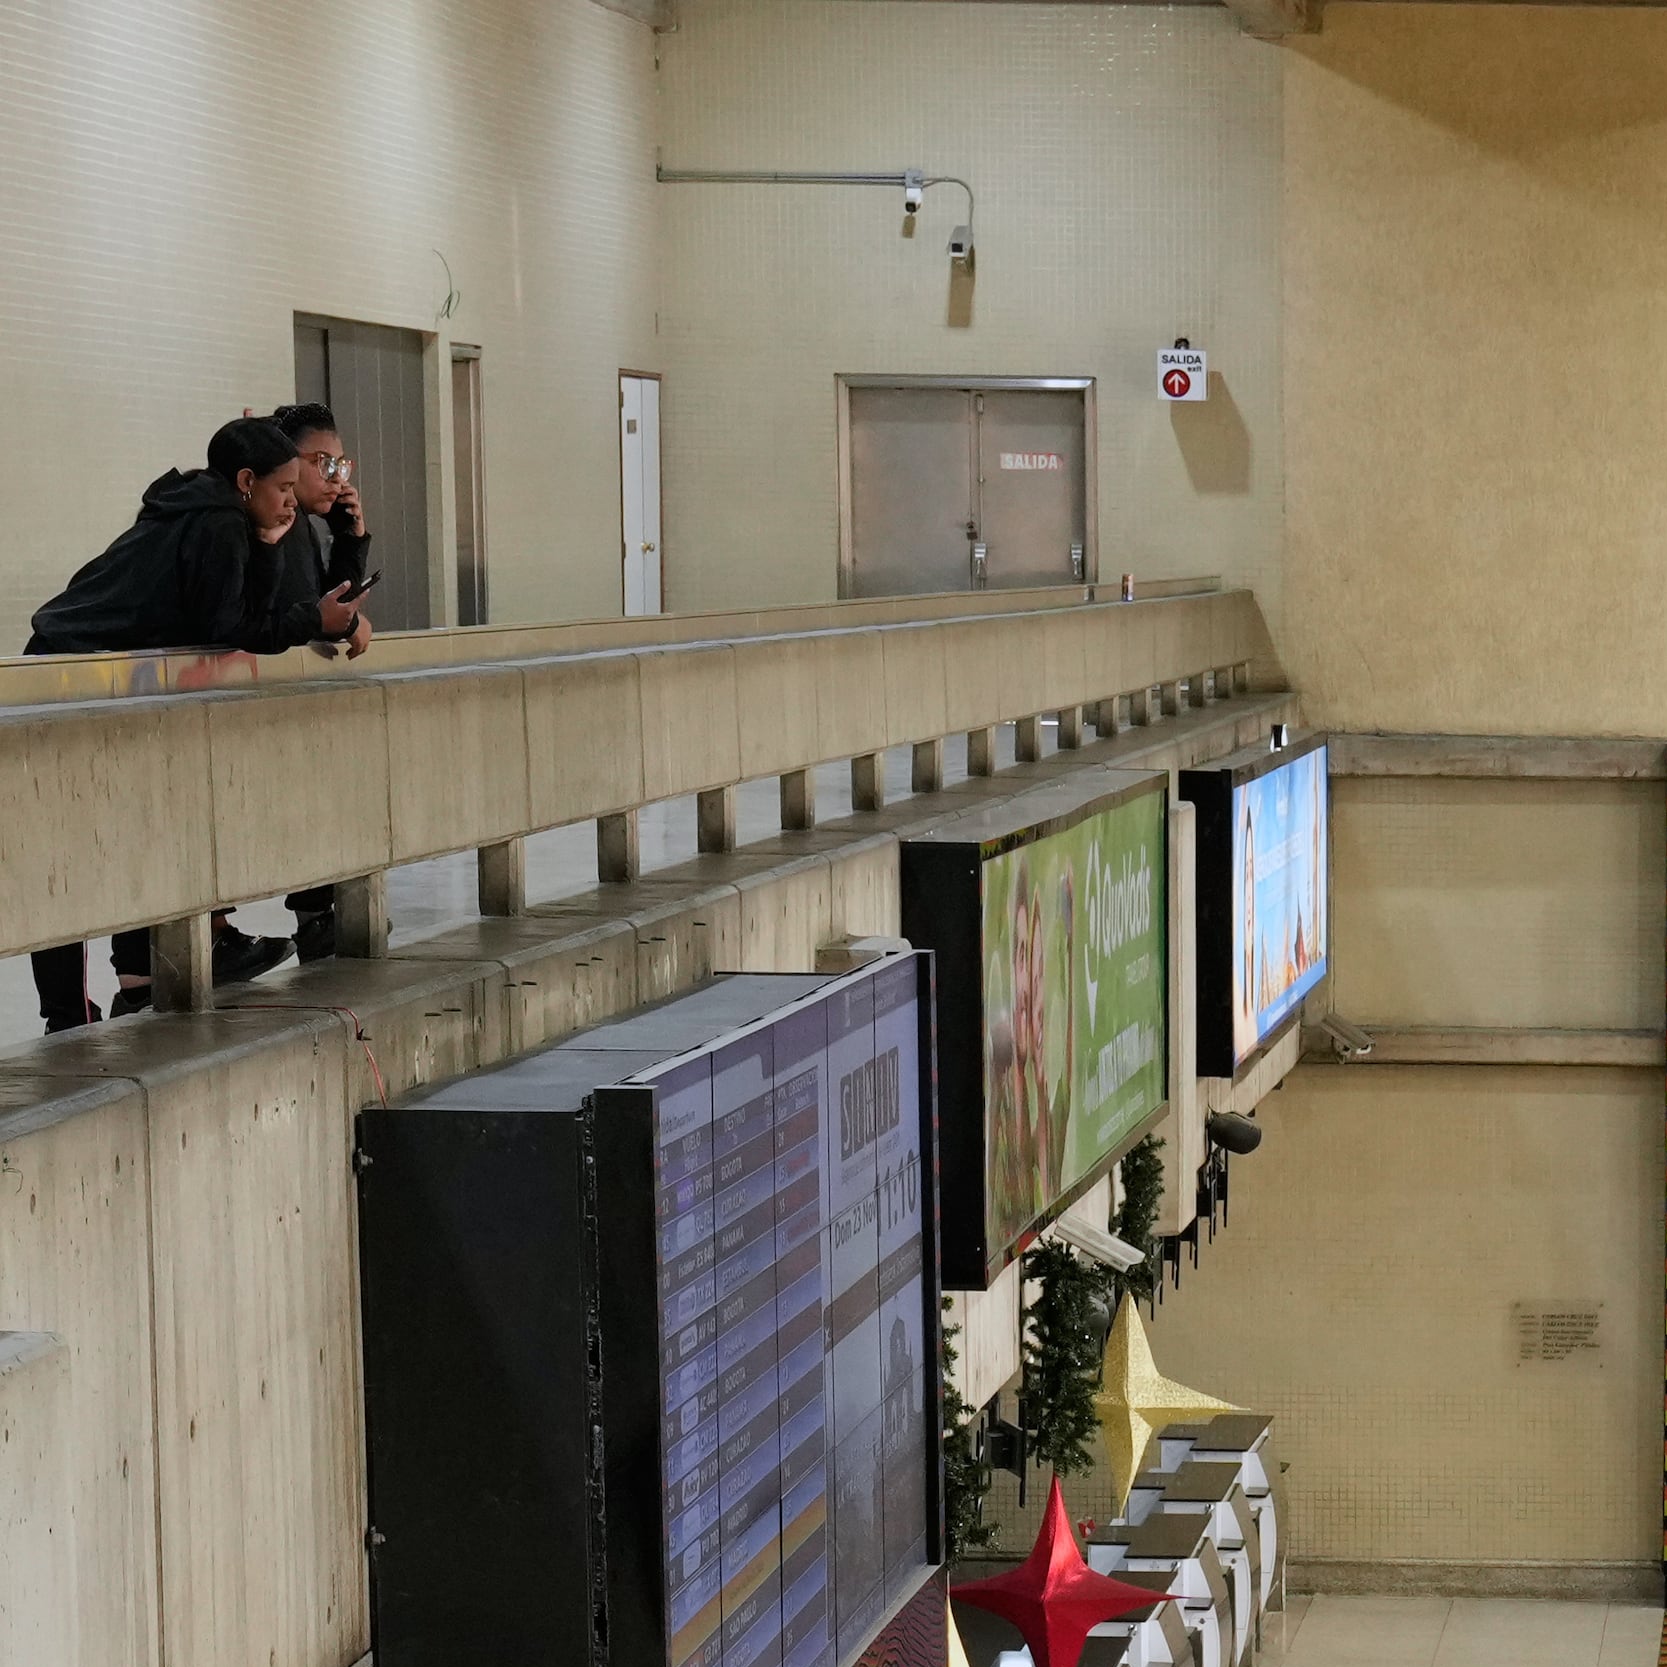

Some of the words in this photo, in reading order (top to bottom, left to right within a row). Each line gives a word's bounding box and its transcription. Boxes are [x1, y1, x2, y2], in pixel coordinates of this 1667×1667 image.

[1162, 354, 1202, 364] SALIDA
[1004, 453, 1058, 469] SALIDA
[853, 1206, 862, 1234] 23
